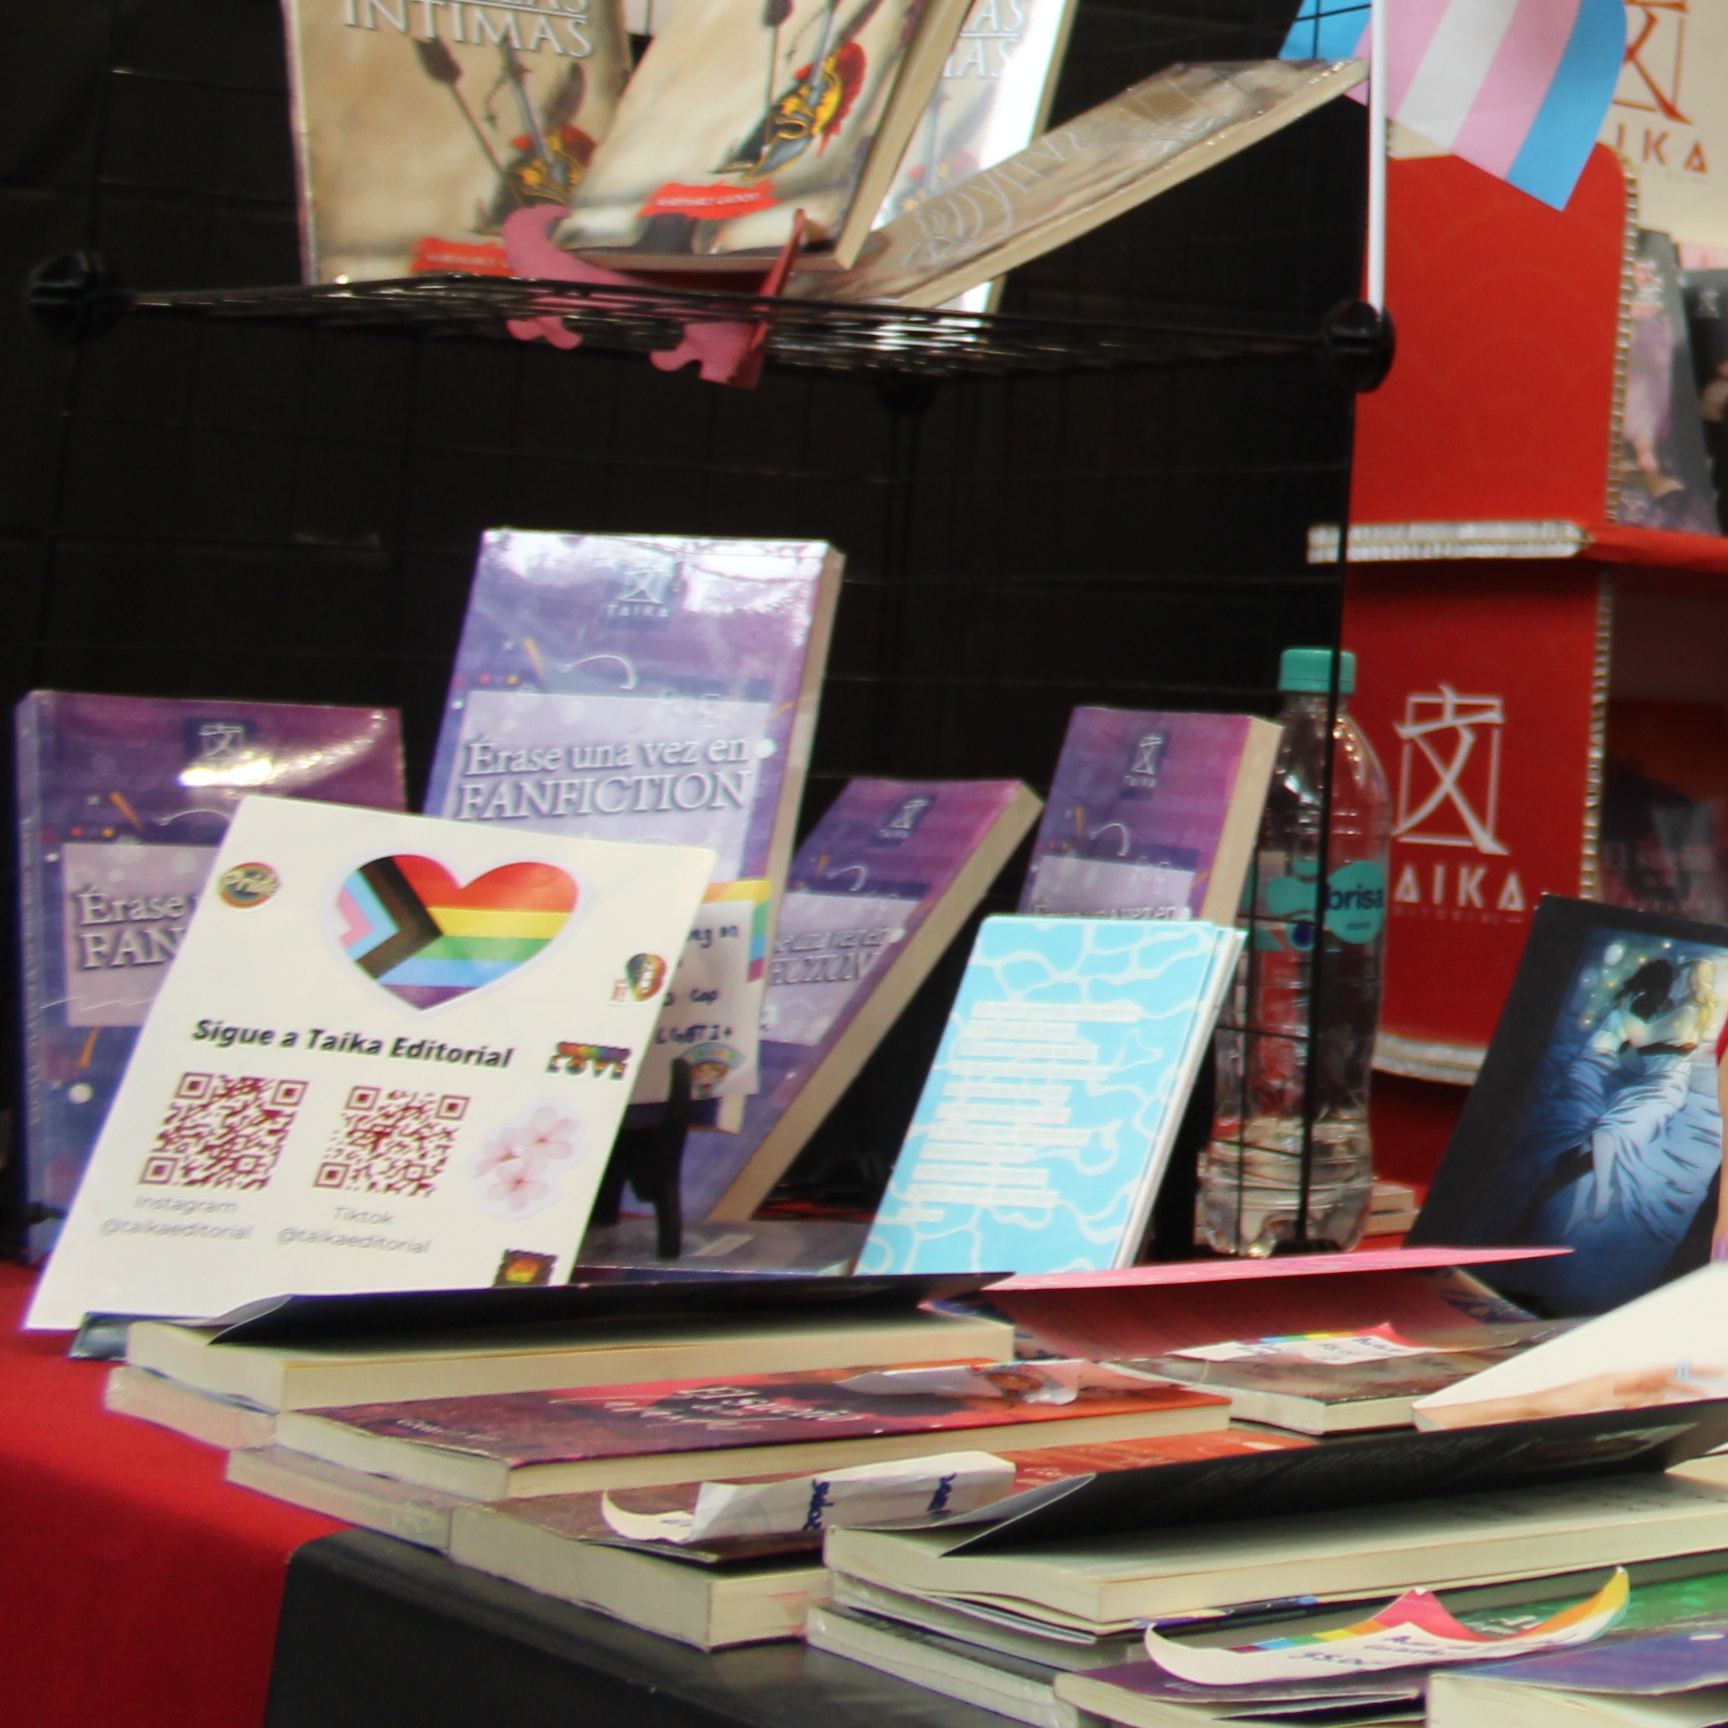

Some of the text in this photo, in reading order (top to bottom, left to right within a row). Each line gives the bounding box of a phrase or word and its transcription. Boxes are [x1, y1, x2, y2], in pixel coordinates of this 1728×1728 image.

[1616, 121, 1709, 175] IKA
[464, 733, 750, 777] Érase una vez en
[456, 770, 752, 821] FANFICTION
[78, 883, 187, 927] Érase
[1394, 862, 1526, 912] AIKA
[193, 1019, 518, 1070] Sigue a Taika Editorial
[134, 1194, 237, 1216] Instagram
[332, 1205, 395, 1225] Tiktok
[99, 1218, 254, 1241] @taikaeditorial
[276, 1226, 434, 1255] @taikaeditorial
